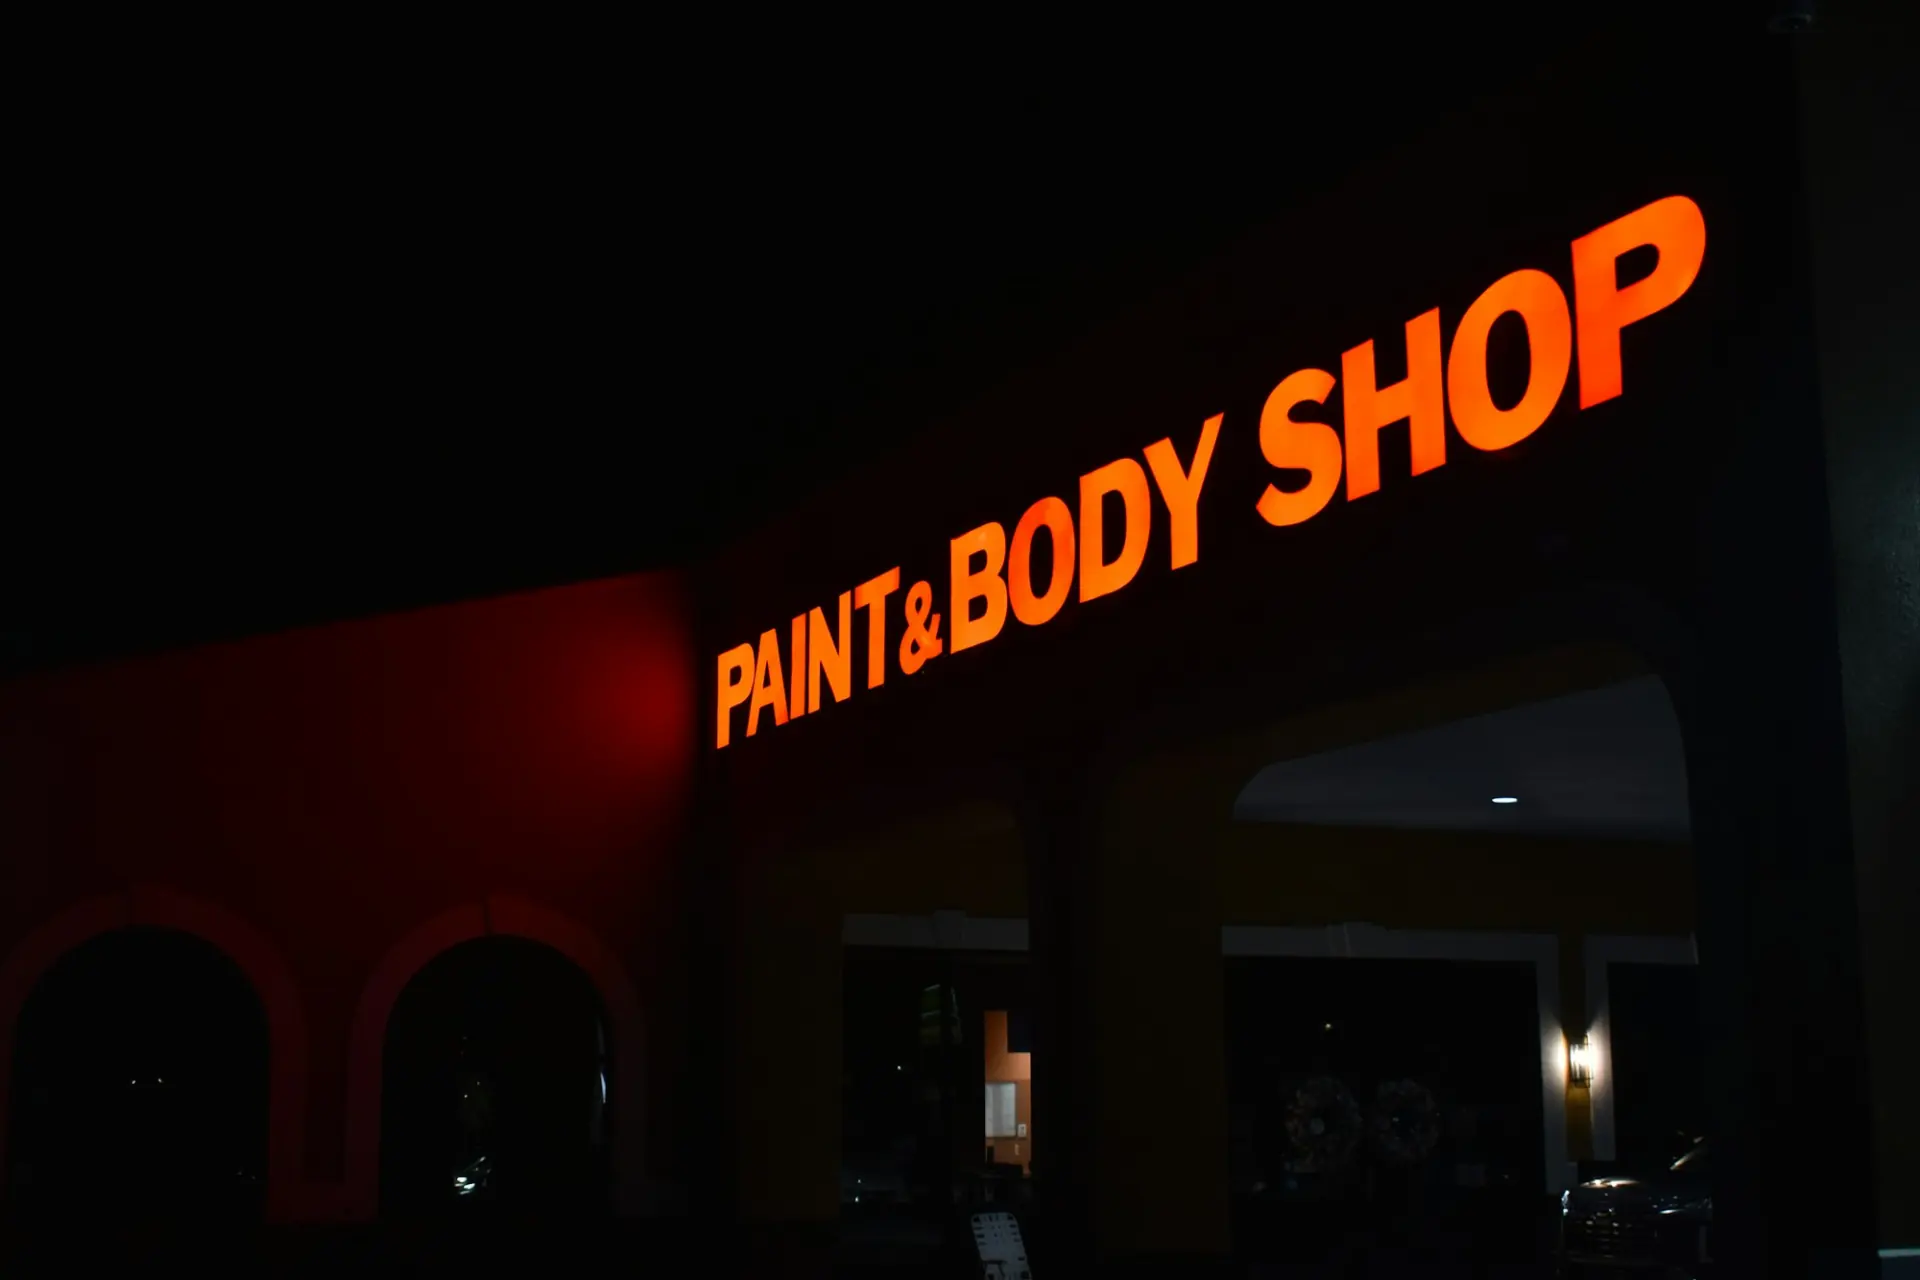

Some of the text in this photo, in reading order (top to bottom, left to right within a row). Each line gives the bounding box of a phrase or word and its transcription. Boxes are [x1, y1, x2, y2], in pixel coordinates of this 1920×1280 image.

[716, 566, 900, 750] PAINT
[950, 412, 1224, 655] BODY
[1255, 195, 1706, 527] SHOP
